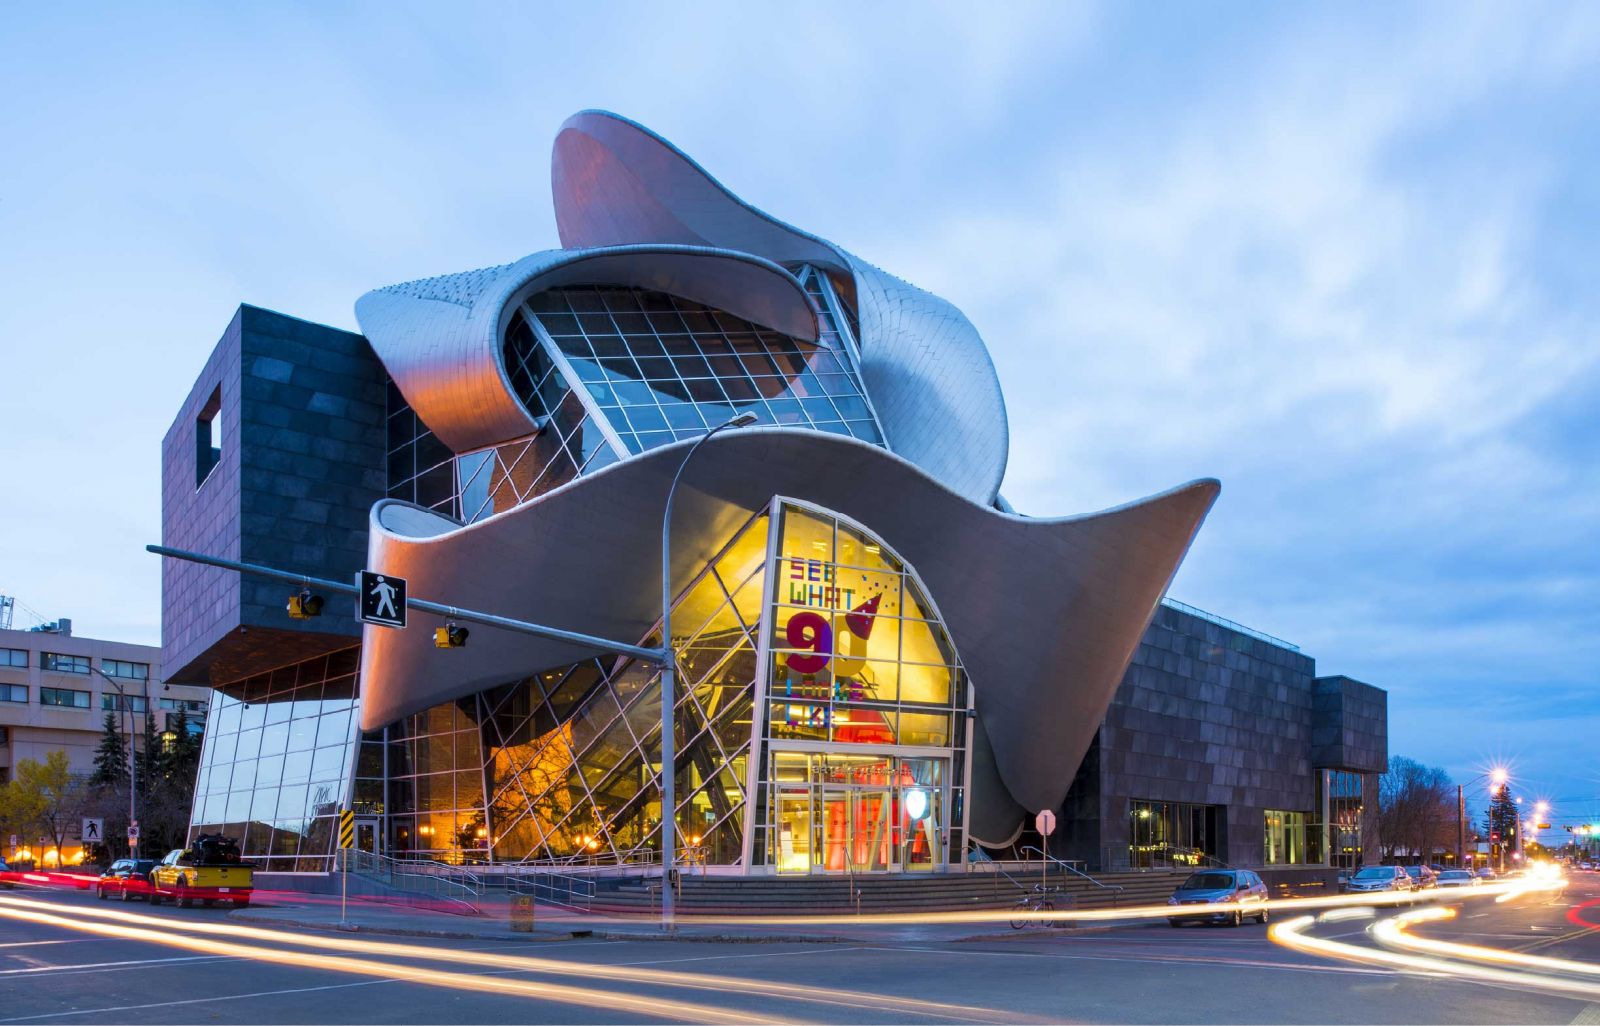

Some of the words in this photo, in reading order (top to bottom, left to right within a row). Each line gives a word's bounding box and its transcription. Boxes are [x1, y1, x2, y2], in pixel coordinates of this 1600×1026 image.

[790, 556, 837, 583] SEE
[790, 582, 856, 610] WHAT
[786, 611, 868, 676] 90
